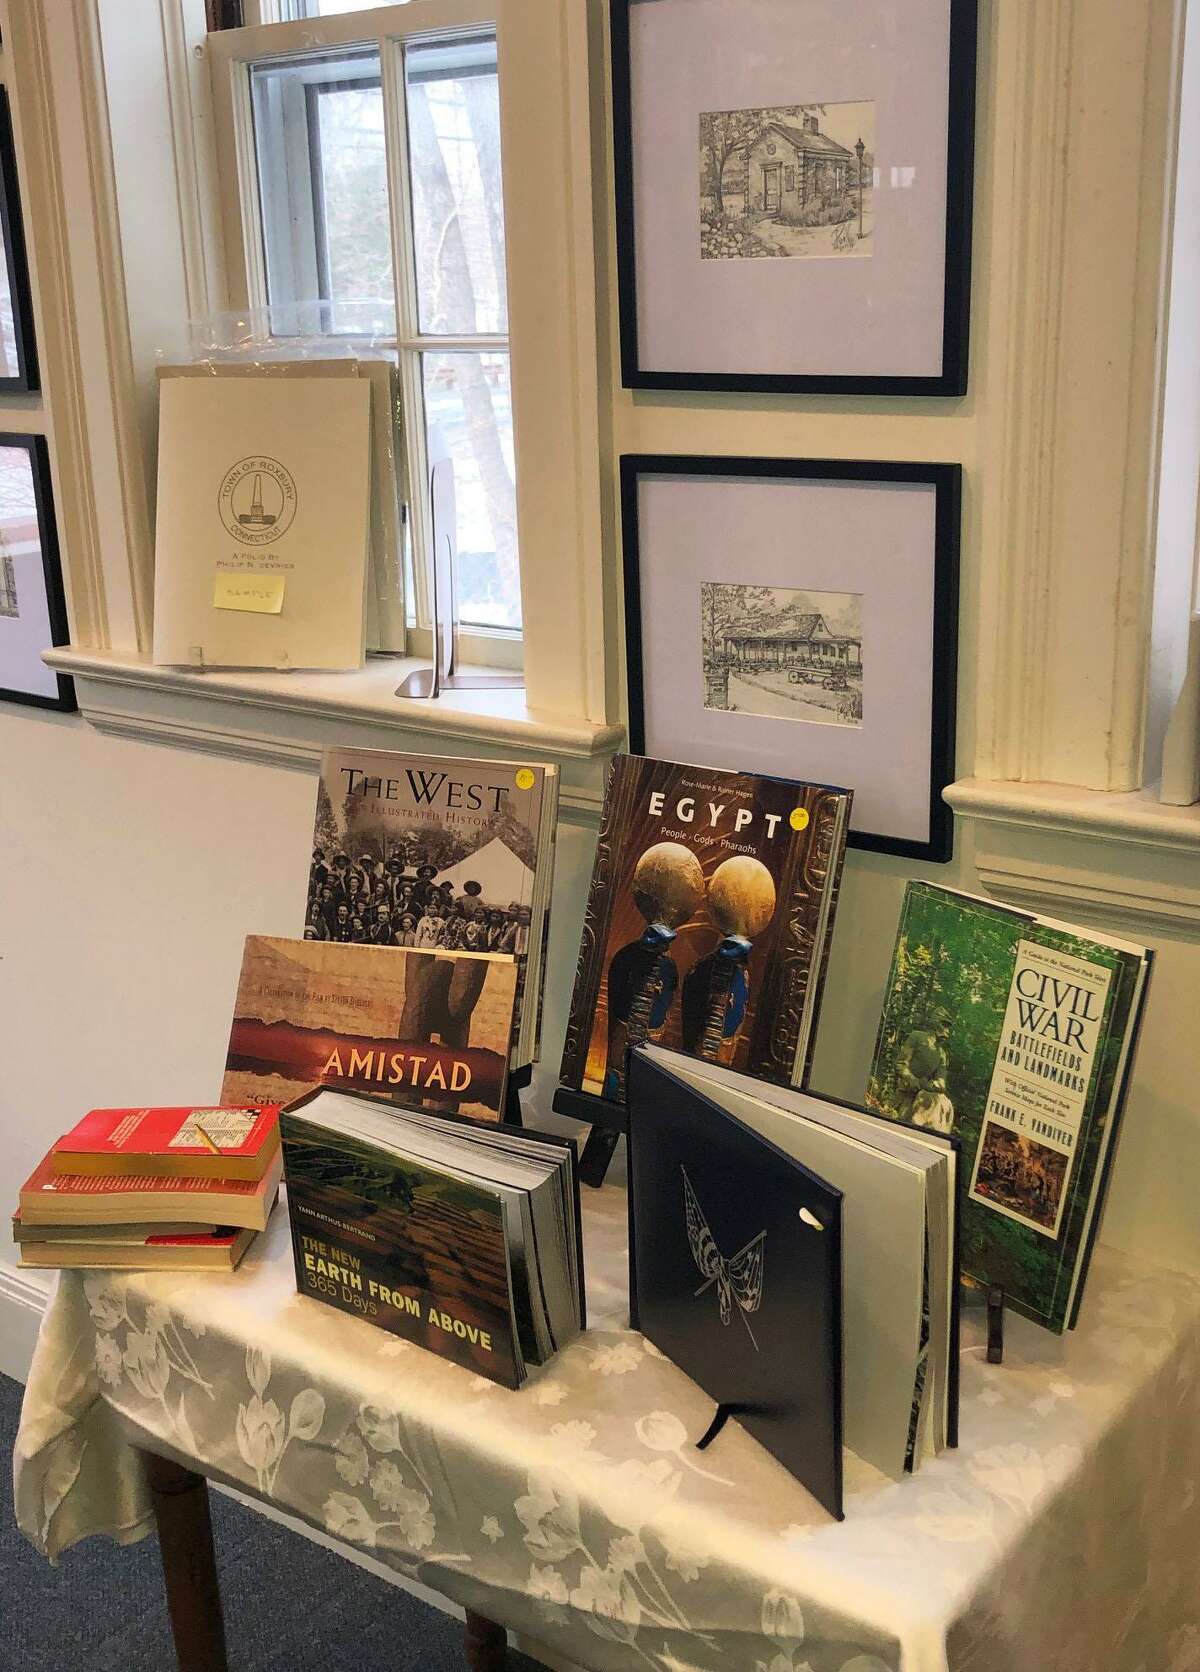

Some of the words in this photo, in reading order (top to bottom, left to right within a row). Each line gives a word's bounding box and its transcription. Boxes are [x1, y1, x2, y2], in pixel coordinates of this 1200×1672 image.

[222, 468, 242, 498] TOWN
[242, 461, 256, 471] OF
[260, 461, 294, 500] ROXBURY
[230, 524, 281, 542] CONNECTICUT
[340, 767, 400, 801] THE
[405, 768, 510, 813] WEST
[648, 791, 782, 839] EGYPT
[660, 826, 687, 840] People
[693, 833, 714, 846] Gods
[720, 839, 757, 855] Pharaohs
[1015, 968, 1100, 1022] CIVIL
[1016, 998, 1089, 1054] WAR
[321, 1047, 472, 1092] AMISTAD
[1000, 1046, 1021, 1066] AND
[1024, 1056, 1085, 1093] LANDMARKS
[1009, 1030, 1082, 1072] BATTLEFIELDS
[989, 1100, 1017, 1122] FRANK
[1018, 1112, 1027, 1127] E.
[1031, 1118, 1073, 1147] VANDIVER
[297, 1204, 316, 1217] YANN
[302, 1236, 329, 1258] THE
[330, 1245, 361, 1272] NEW
[304, 1252, 362, 1292] EARTH
[368, 1279, 422, 1319] FROM
[428, 1307, 493, 1352] ABOVE
[307, 1270, 338, 1297] 365
[341, 1286, 378, 1317] Days
